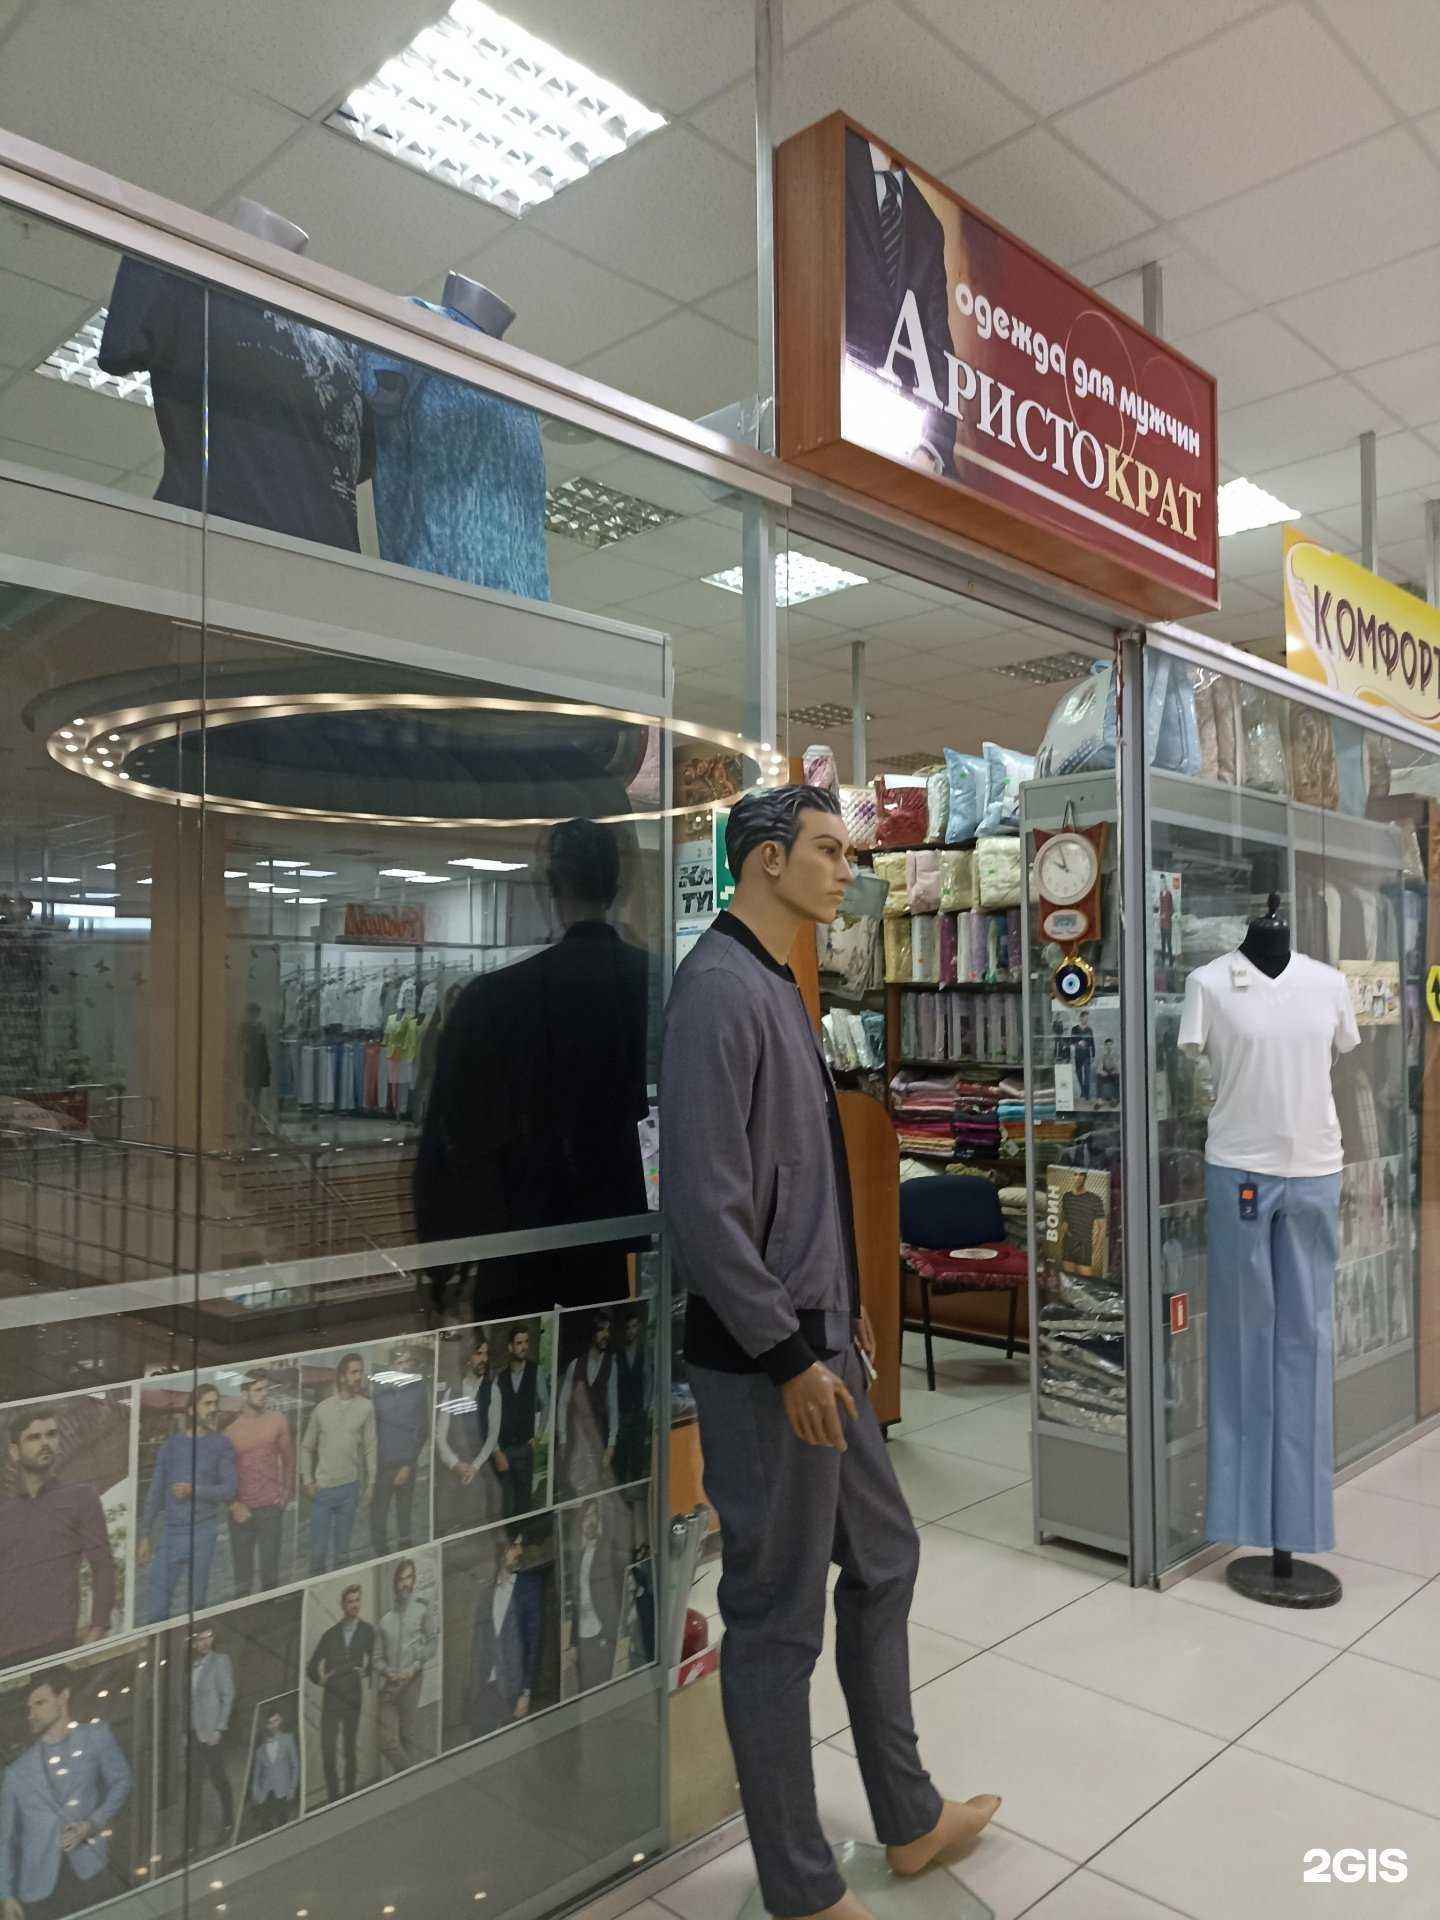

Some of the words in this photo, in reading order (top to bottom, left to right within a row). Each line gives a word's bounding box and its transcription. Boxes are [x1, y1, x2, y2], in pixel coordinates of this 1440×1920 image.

[955, 283, 1067, 377] одежда
[1072, 357, 1115, 406] для
[1119, 386, 1200, 458] мужчин
